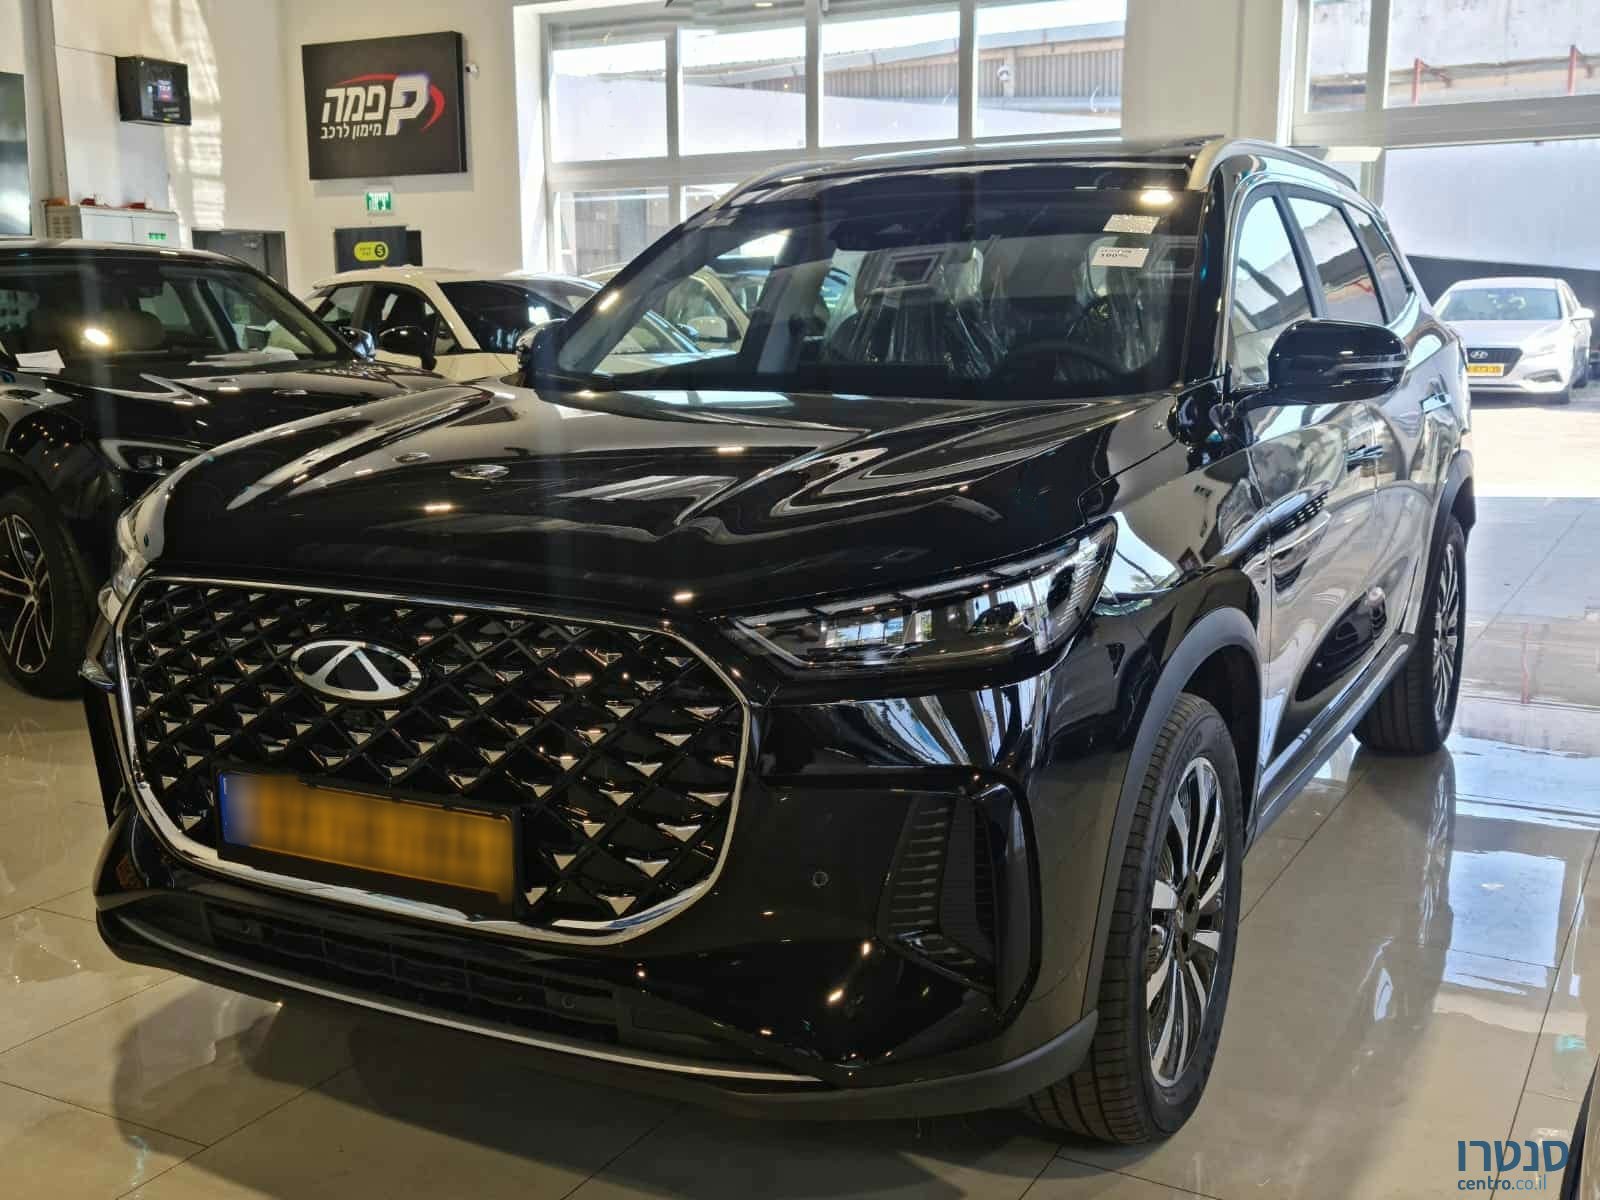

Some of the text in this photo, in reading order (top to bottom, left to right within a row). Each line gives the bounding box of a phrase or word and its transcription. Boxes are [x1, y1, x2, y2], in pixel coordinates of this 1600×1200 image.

[320, 84, 386, 123] פמה
[320, 122, 382, 140] מימון לרכב
